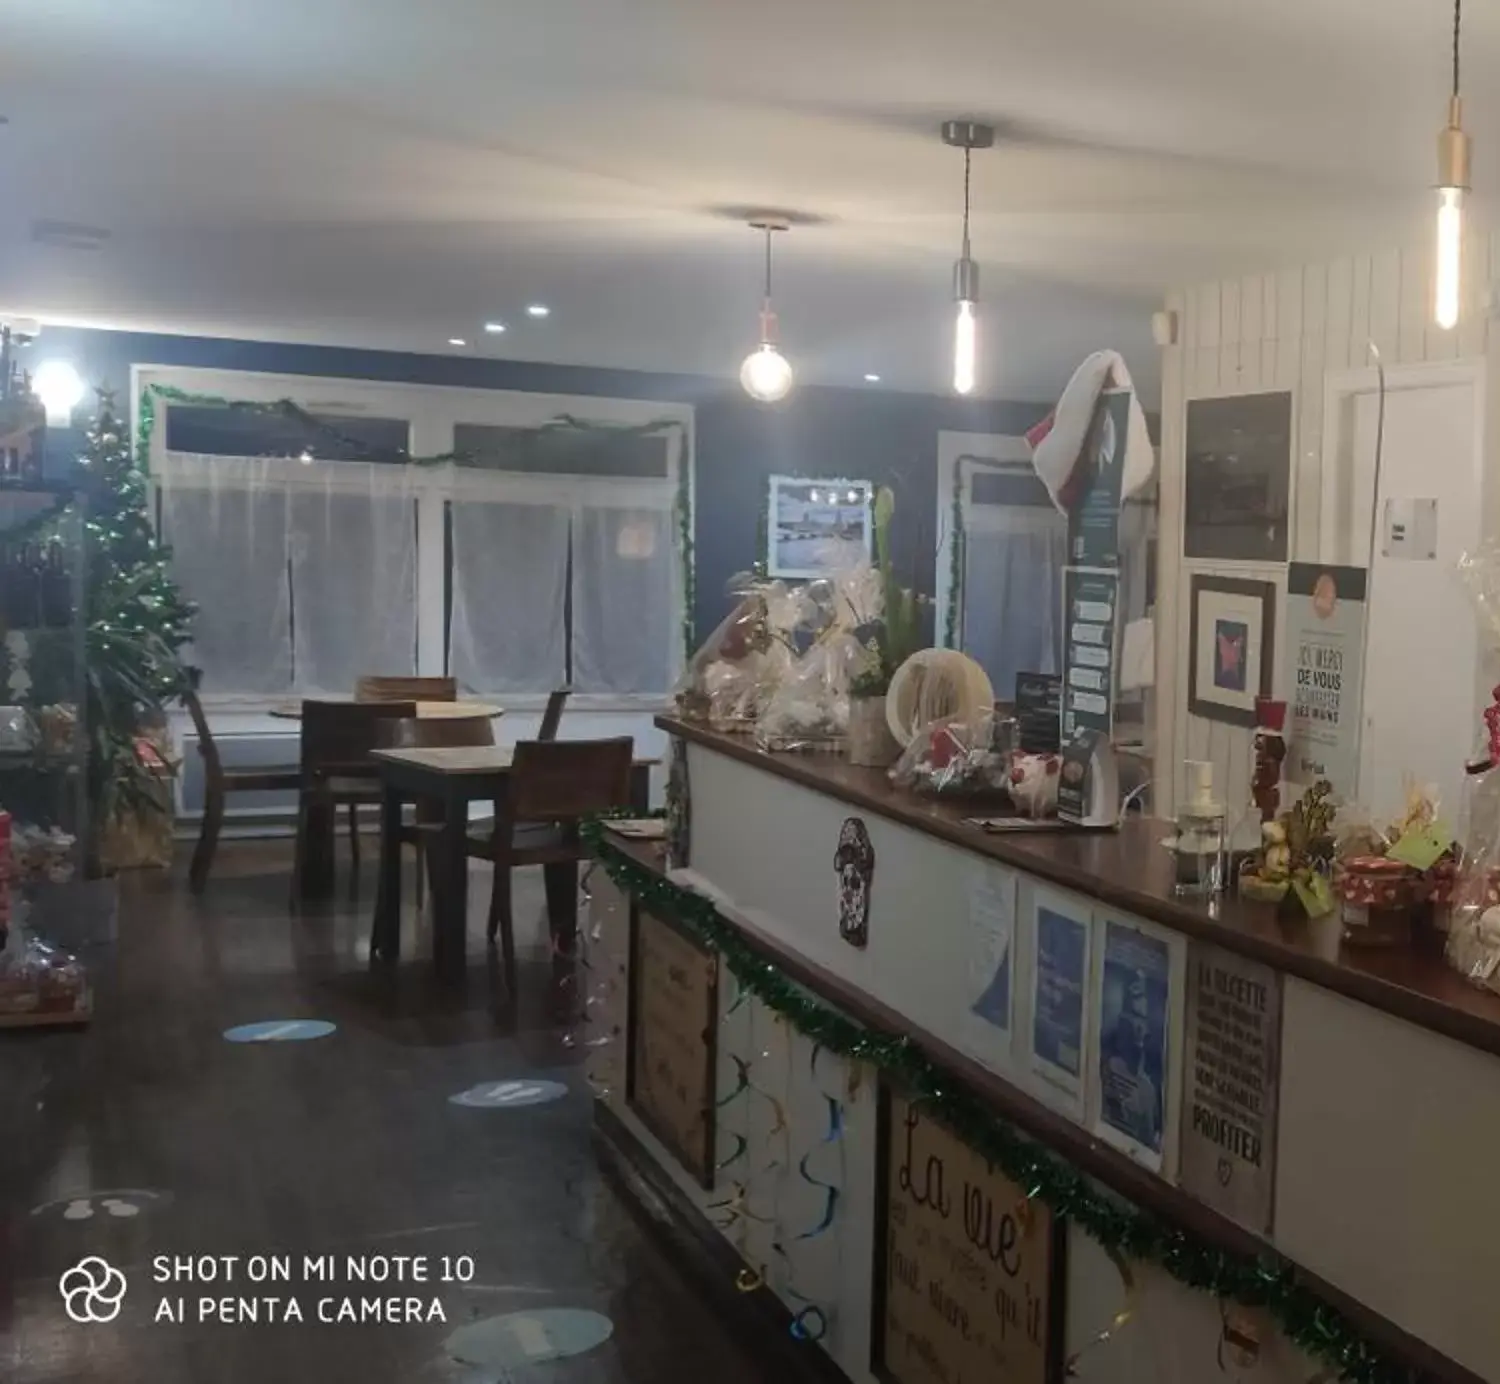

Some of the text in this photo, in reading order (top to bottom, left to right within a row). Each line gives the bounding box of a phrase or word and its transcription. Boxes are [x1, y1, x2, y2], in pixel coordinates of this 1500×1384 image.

[1297, 668, 1342, 691] DE VOUS
[1192, 1105, 1262, 1168] PROFITER
[900, 1102, 1021, 1277] La vie
